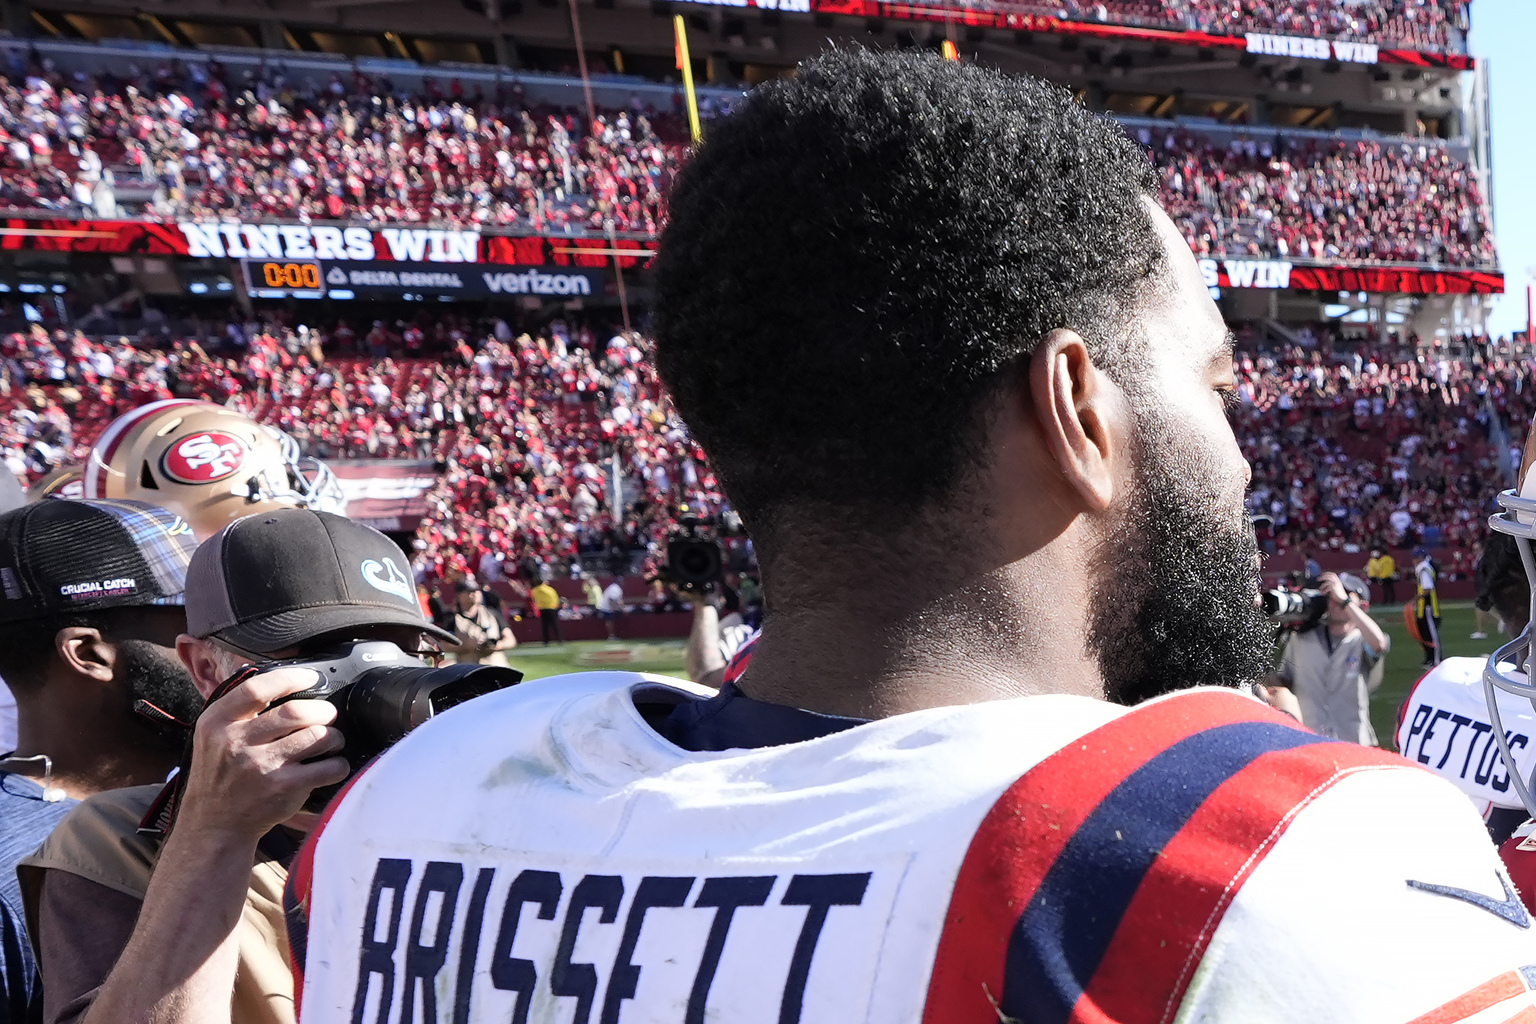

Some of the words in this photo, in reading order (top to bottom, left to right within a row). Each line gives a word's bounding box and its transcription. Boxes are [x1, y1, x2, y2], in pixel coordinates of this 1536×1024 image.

[1246, 33, 1330, 60] NINERS
[1332, 41, 1379, 64] WIN
[178, 223, 375, 260] NINERS
[382, 228, 481, 263] WIN
[263, 262, 321, 288] 0:00
[482, 269, 591, 295] verizon
[1224, 260, 1293, 288] WIN
[61, 580, 103, 595] CRUCIAL
[103, 578, 136, 590] CATCH
[1404, 704, 1528, 793] PETTUS
